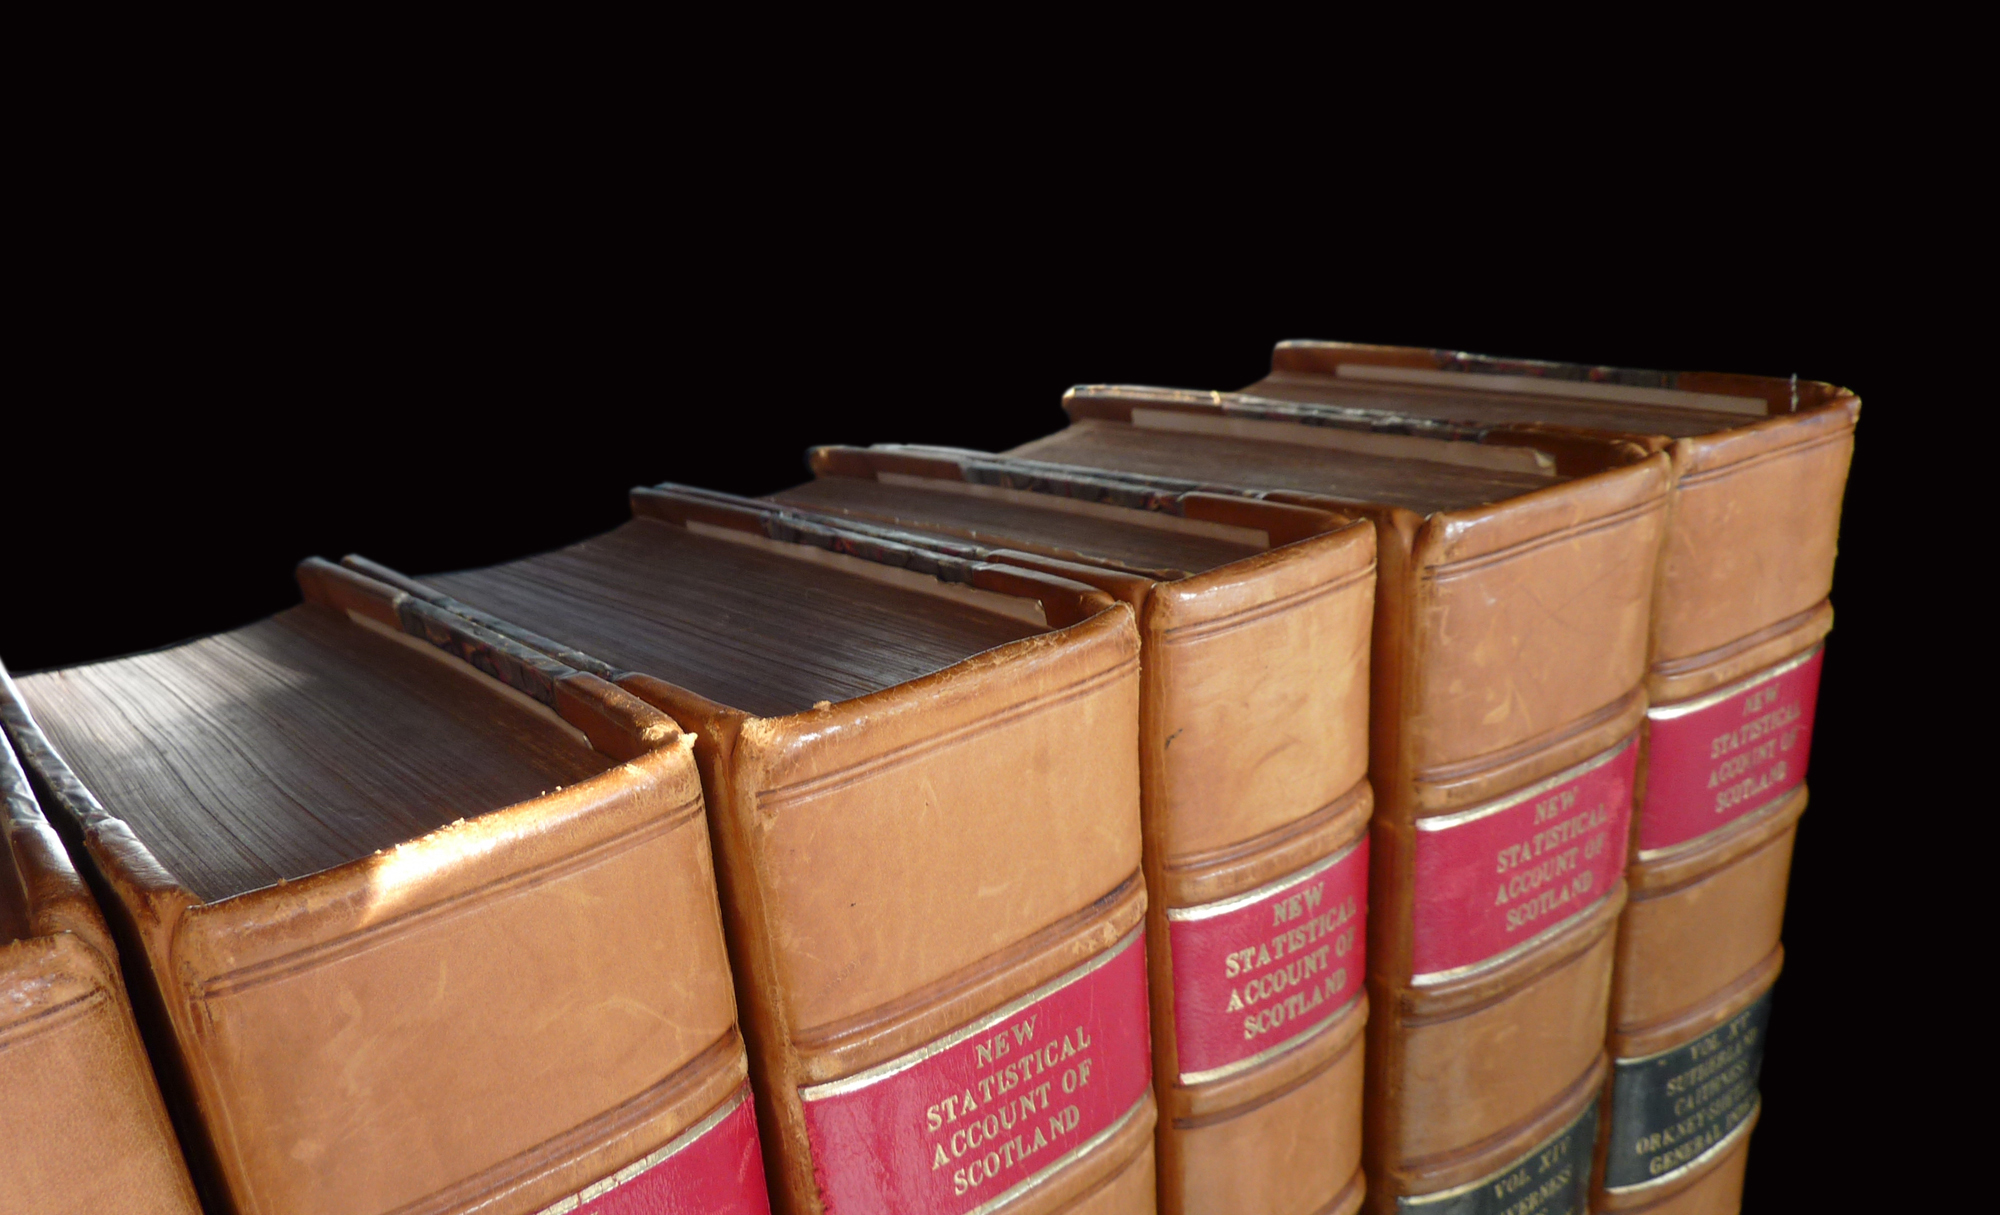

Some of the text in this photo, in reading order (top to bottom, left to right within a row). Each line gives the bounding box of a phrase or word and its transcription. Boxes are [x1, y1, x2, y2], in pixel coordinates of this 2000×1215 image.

[1707, 738, 1777, 789] ACCOUNT
[1711, 700, 1801, 761] STATISTICAL
[1533, 786, 1580, 825] NEW
[1715, 760, 1788, 814] SCOTLAND
[1495, 831, 1607, 906] ACCOUNT OF
[1496, 803, 1607, 874] STATISTICAL
[1272, 881, 1326, 927] NEW
[1506, 870, 1594, 932] SCOTLAND
[1225, 895, 1357, 979] STATISTICAL
[1226, 925, 1357, 1013] ACCOUNT OF
[1243, 967, 1348, 1040] SCOTLAND
[975, 1014, 1039, 1069] NEW
[926, 1025, 1093, 1133] STATISTICAL
[931, 1057, 1094, 1171] ACCOUNT OF
[952, 1104, 1081, 1197] SCOTLAND
